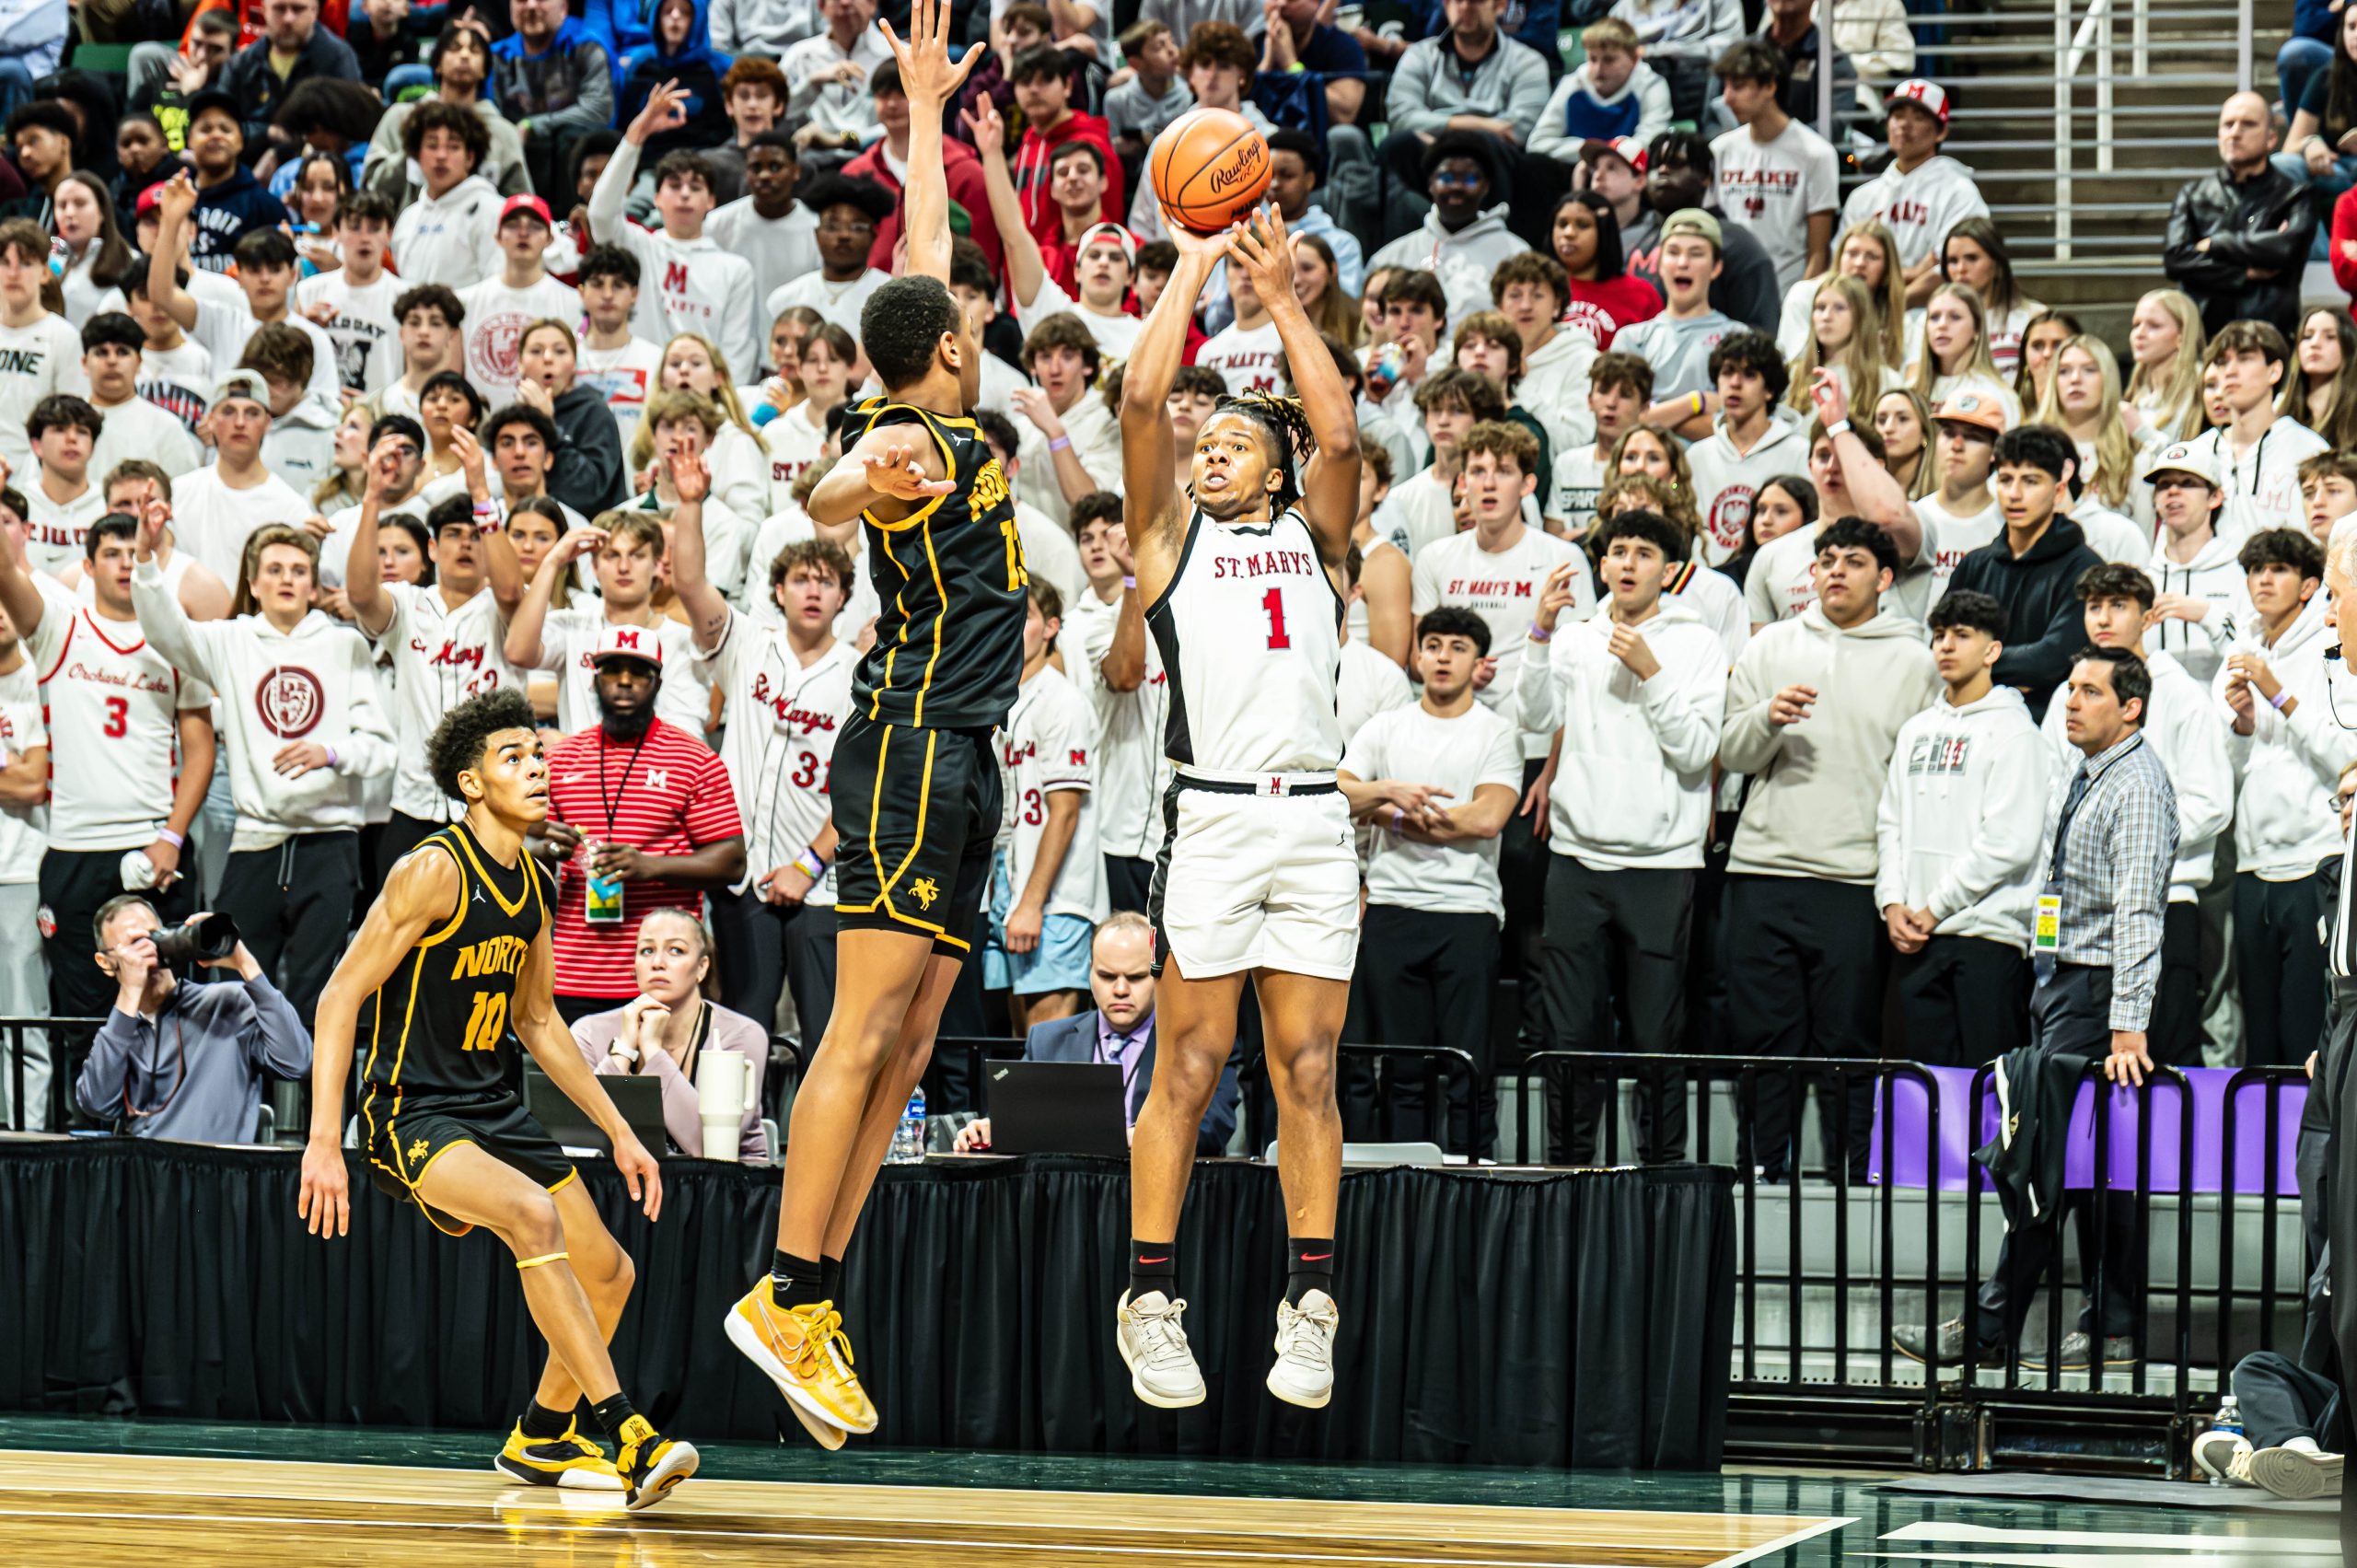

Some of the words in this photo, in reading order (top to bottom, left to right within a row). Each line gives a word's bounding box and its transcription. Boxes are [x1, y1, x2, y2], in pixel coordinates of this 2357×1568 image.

[663, 260, 689, 294] M
[1214, 555, 1245, 579] ST.
[1246, 550, 1313, 578] MARYS
[1469, 580, 1509, 596] MARY'S
[1260, 587, 1291, 650] 1
[615, 630, 641, 650] M
[69, 662, 129, 686] Orchard
[131, 672, 169, 694] Lake
[103, 694, 129, 739] 3
[770, 692, 836, 735] Mary's
[1069, 749, 1086, 766] M
[644, 769, 668, 789] M
[1270, 776, 1282, 795] M
[461, 991, 507, 1051] 10
